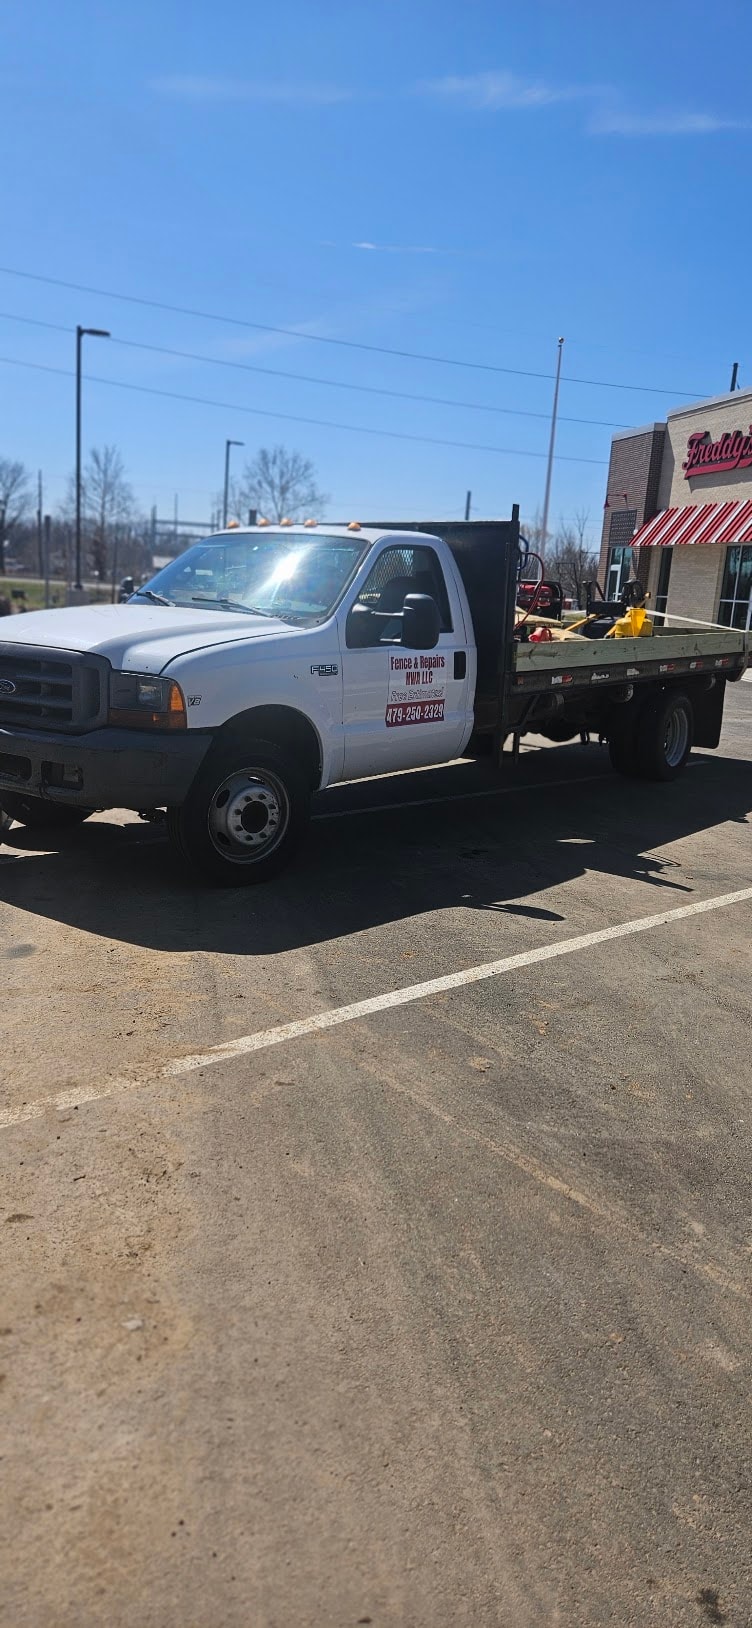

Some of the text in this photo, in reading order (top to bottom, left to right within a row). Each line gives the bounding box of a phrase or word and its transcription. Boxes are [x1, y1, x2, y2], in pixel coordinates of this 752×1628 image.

[391, 654, 445, 670] Fence & Repairs
[406, 670, 433, 685] NWA LLC
[386, 703, 444, 723] 479-250-2329
